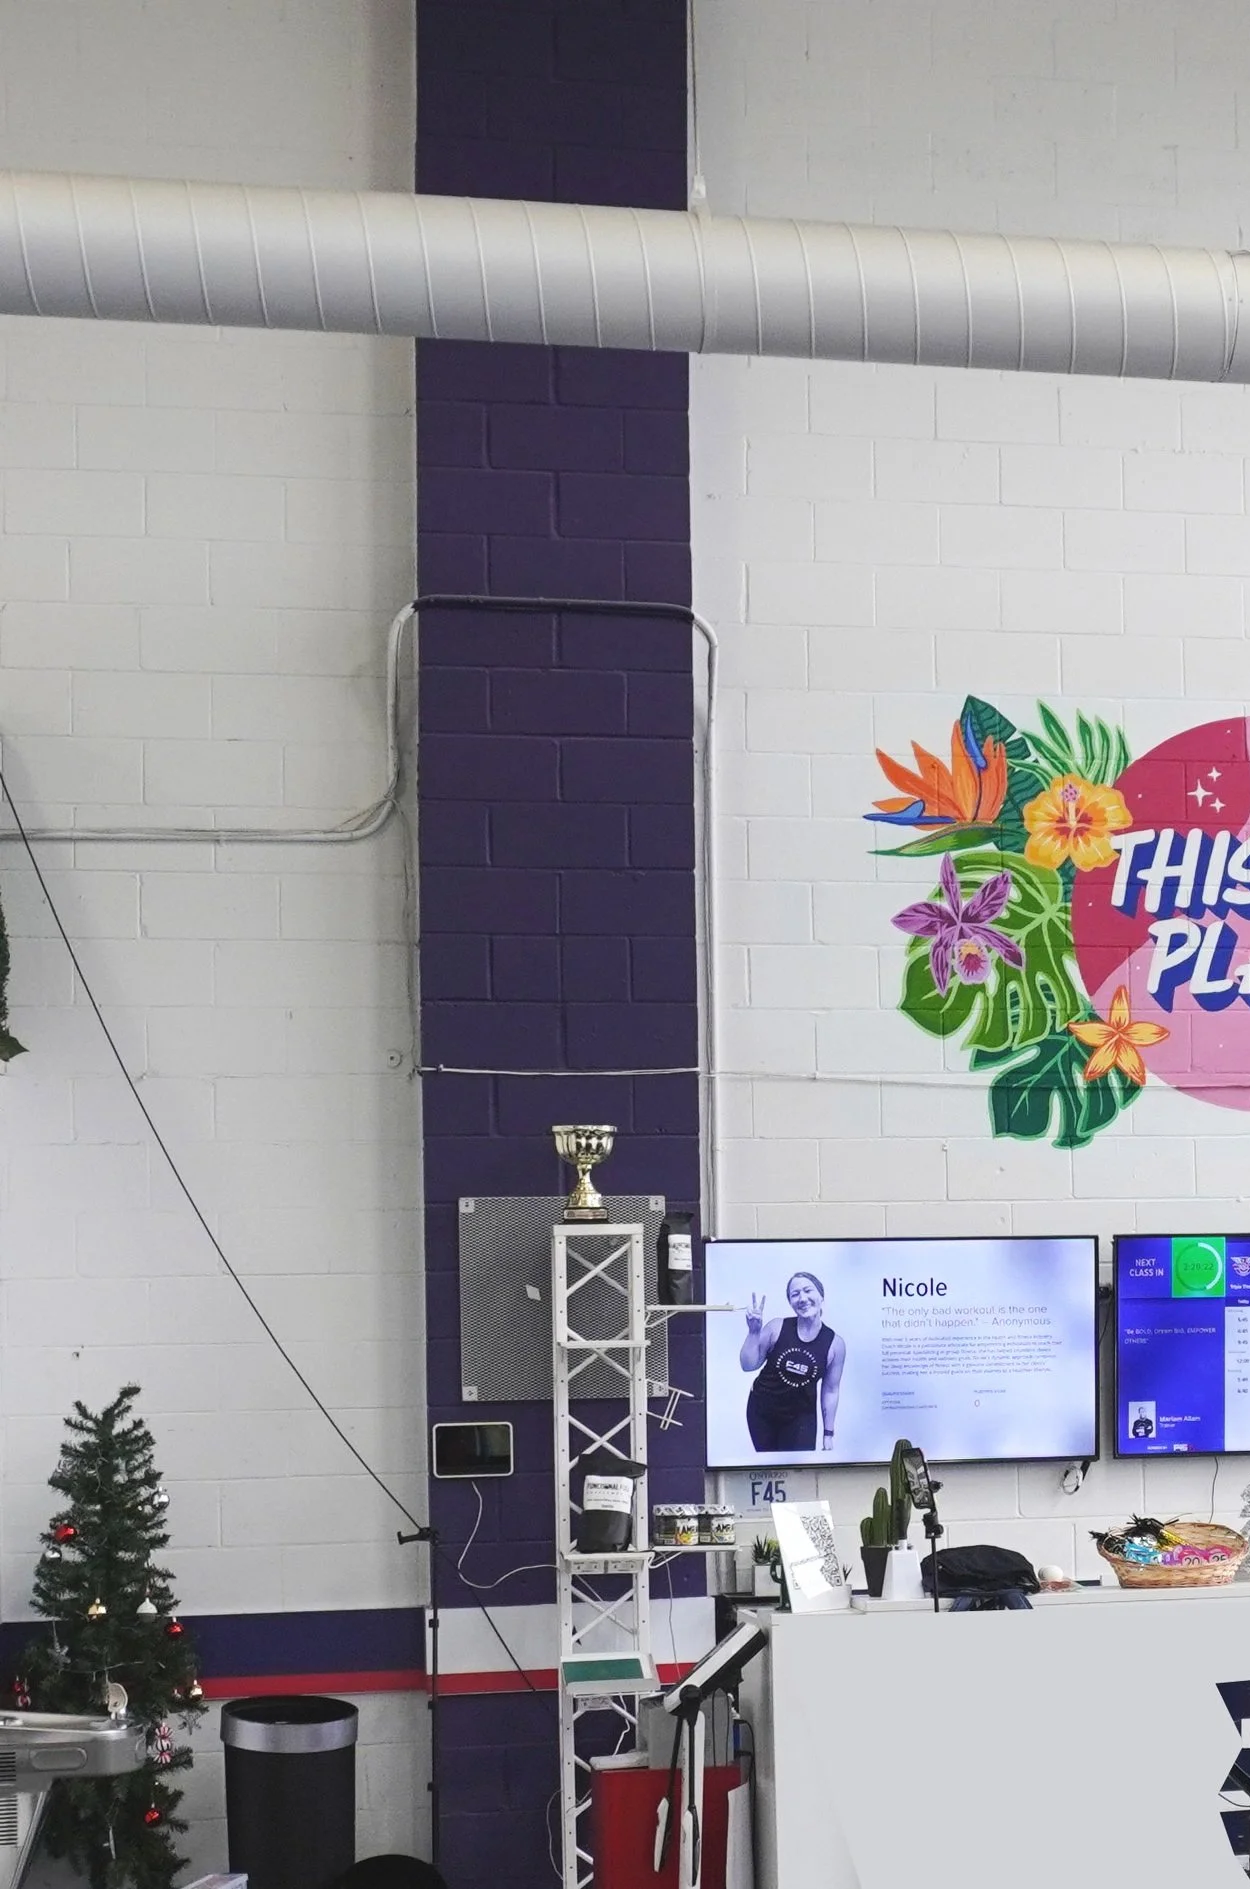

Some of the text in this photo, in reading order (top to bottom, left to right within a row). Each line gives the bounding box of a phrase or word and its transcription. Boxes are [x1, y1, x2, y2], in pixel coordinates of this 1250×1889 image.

[1135, 1259, 1156, 1267] NEXT
[1129, 1268, 1164, 1277] CLASS IN
[883, 1277, 947, 1297] Nicole
[908, 1306, 929, 1317] only
[932, 1306, 952, 1315] bad
[954, 1305, 995, 1315] workout
[998, 1305, 1006, 1314] is
[1008, 1306, 1025, 1314] the
[881, 1319, 901, 1328] that
[992, 1317, 1052, 1327] Anonymous
[751, 1480, 787, 1506] F45
